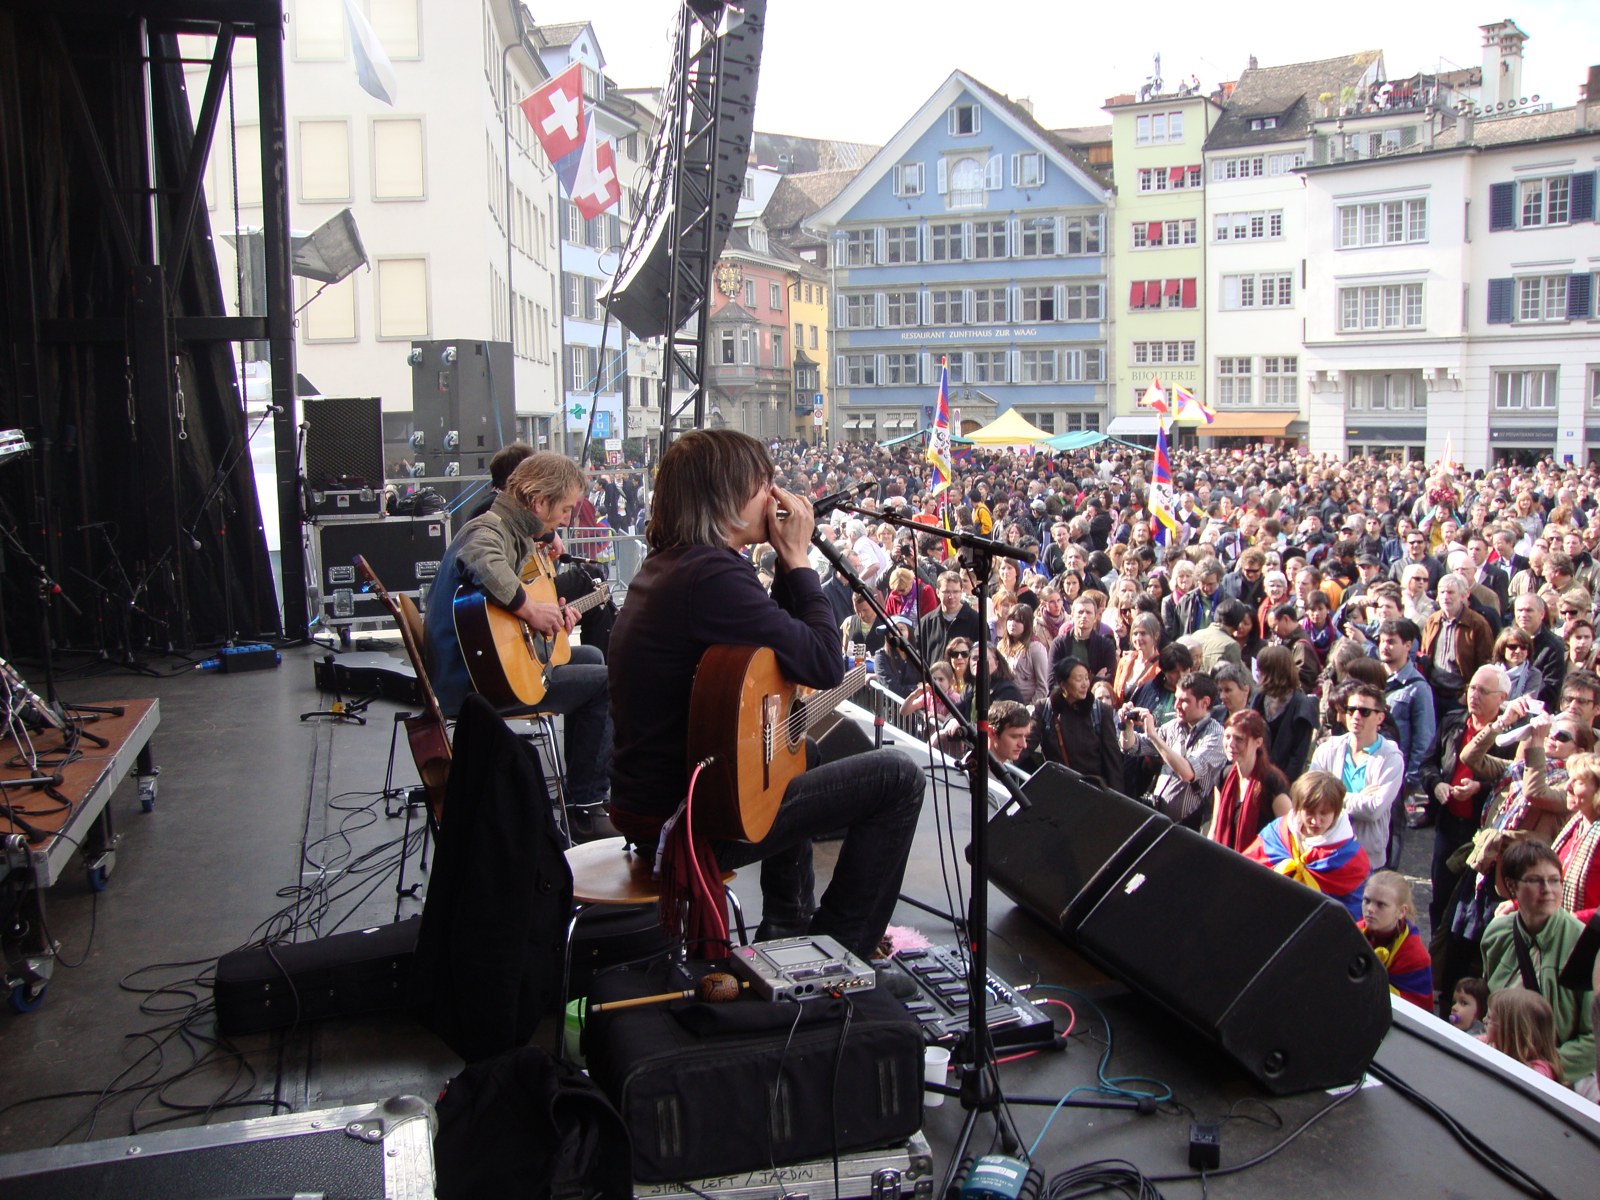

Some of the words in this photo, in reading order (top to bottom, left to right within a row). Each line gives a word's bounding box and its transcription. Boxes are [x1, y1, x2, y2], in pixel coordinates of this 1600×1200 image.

[901, 332, 946, 340] RESTAURANT
[949, 330, 992, 339] ZUNFTHAUS
[995, 329, 1010, 337] ZUR
[1014, 328, 1037, 336] WAAG
[1131, 370, 1196, 381] BIJOUTERIE
[651, 1183, 691, 1194] STAG
[702, 1175, 739, 1190] LEFT
[745, 1171, 753, 1186] /
[759, 1168, 814, 1184] JARDIN
